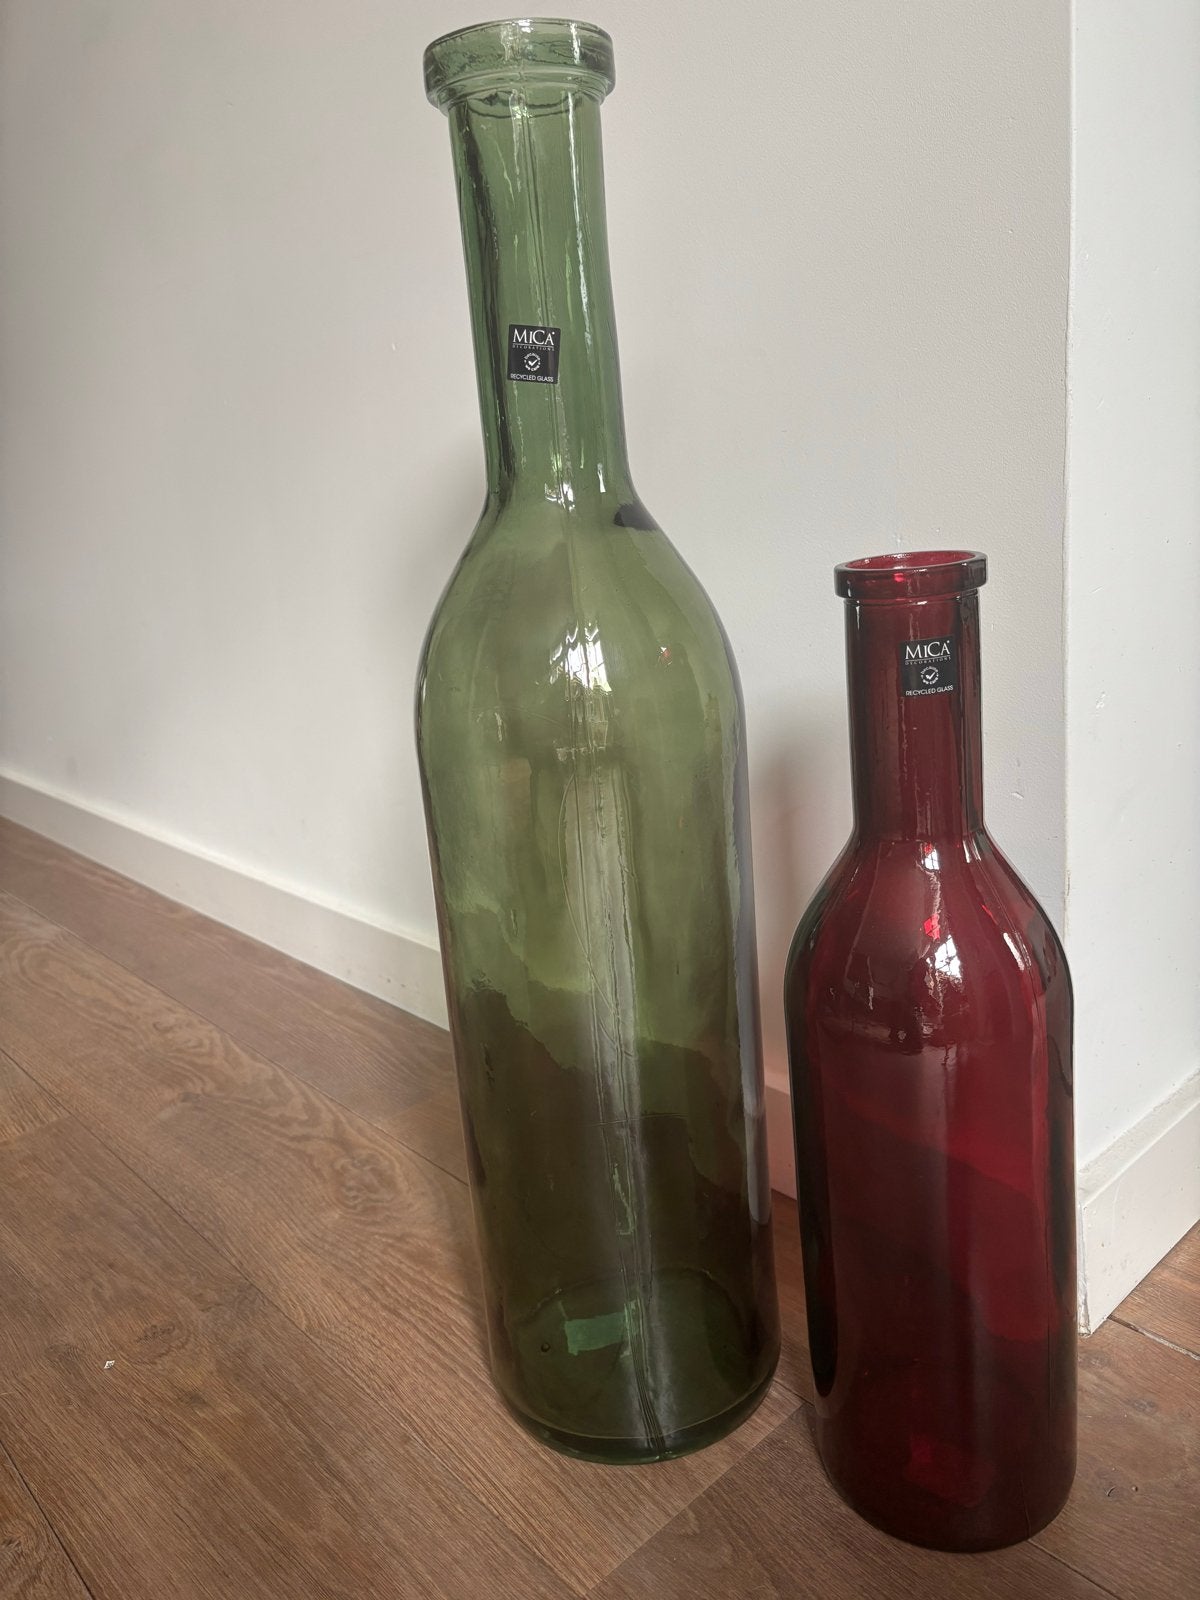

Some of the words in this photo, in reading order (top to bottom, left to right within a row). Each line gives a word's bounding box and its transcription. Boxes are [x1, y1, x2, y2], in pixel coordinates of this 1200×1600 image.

[510, 373, 536, 381] RECYCLED
[905, 687, 936, 696] RECYCLED
[936, 684, 954, 693] GLASS
